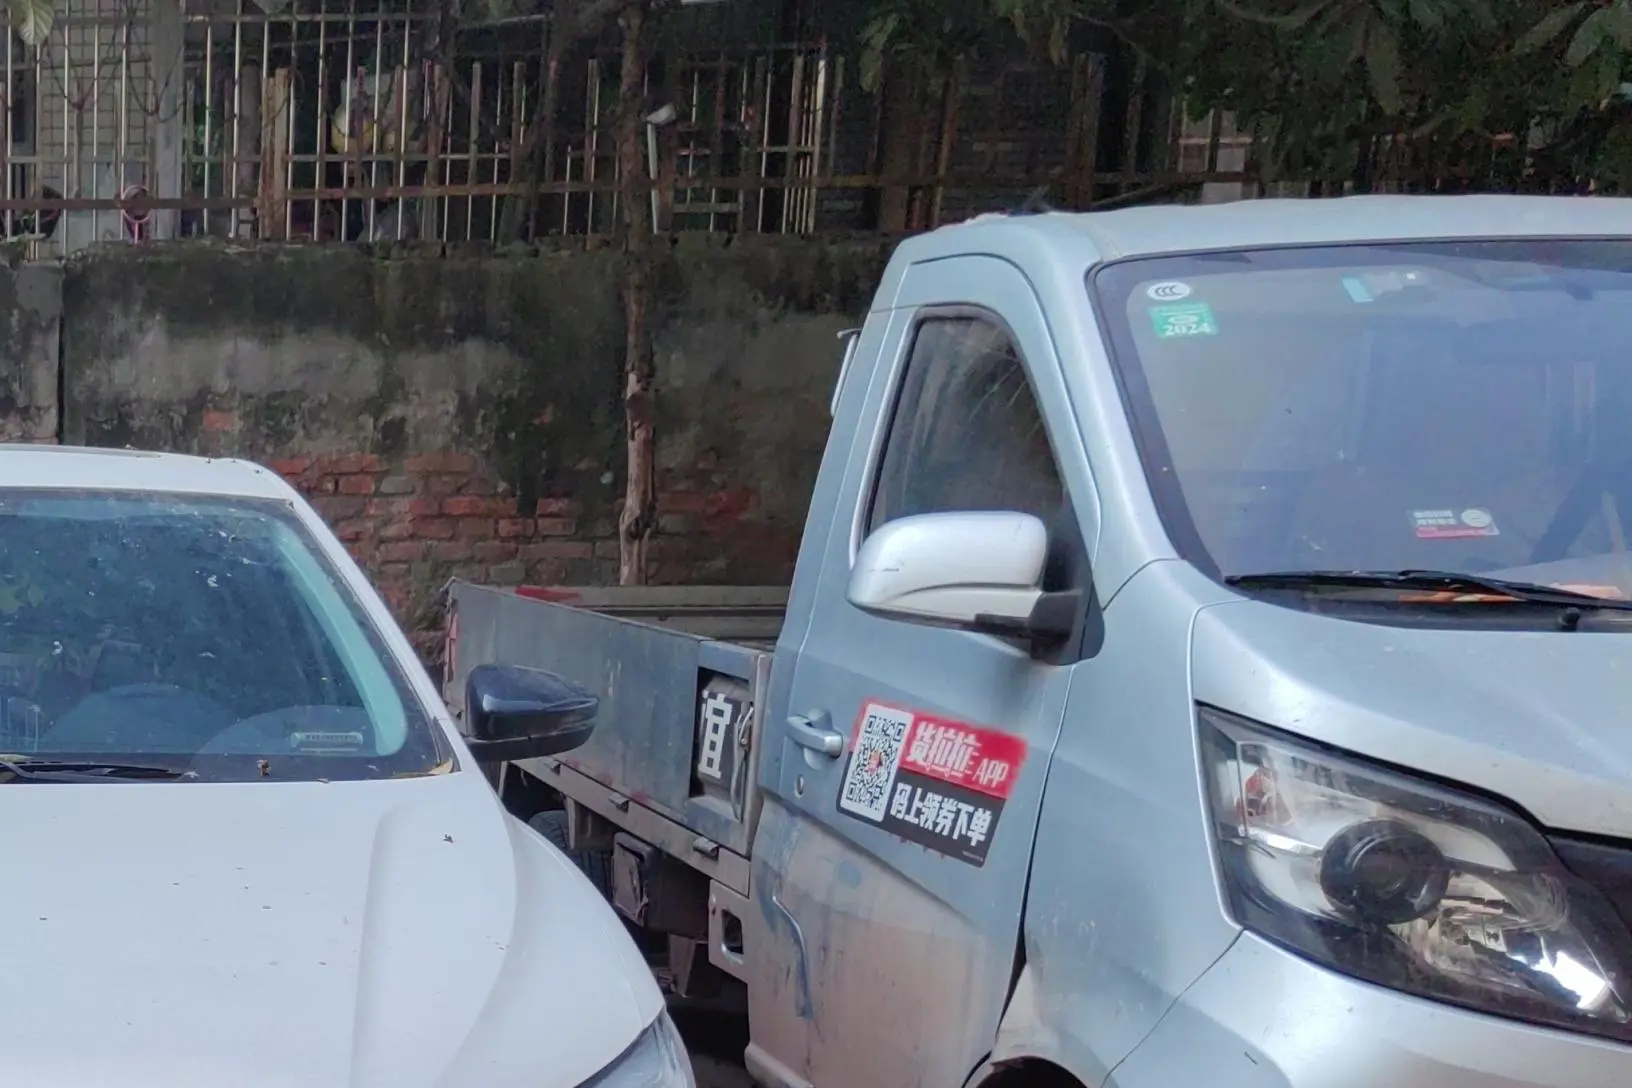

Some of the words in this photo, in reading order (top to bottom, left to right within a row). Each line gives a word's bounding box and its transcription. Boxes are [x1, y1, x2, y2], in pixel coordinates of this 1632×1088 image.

[1164, 322, 1211, 336] 2024
[906, 721, 982, 777] 货拉拉
[971, 757, 1010, 788] APP
